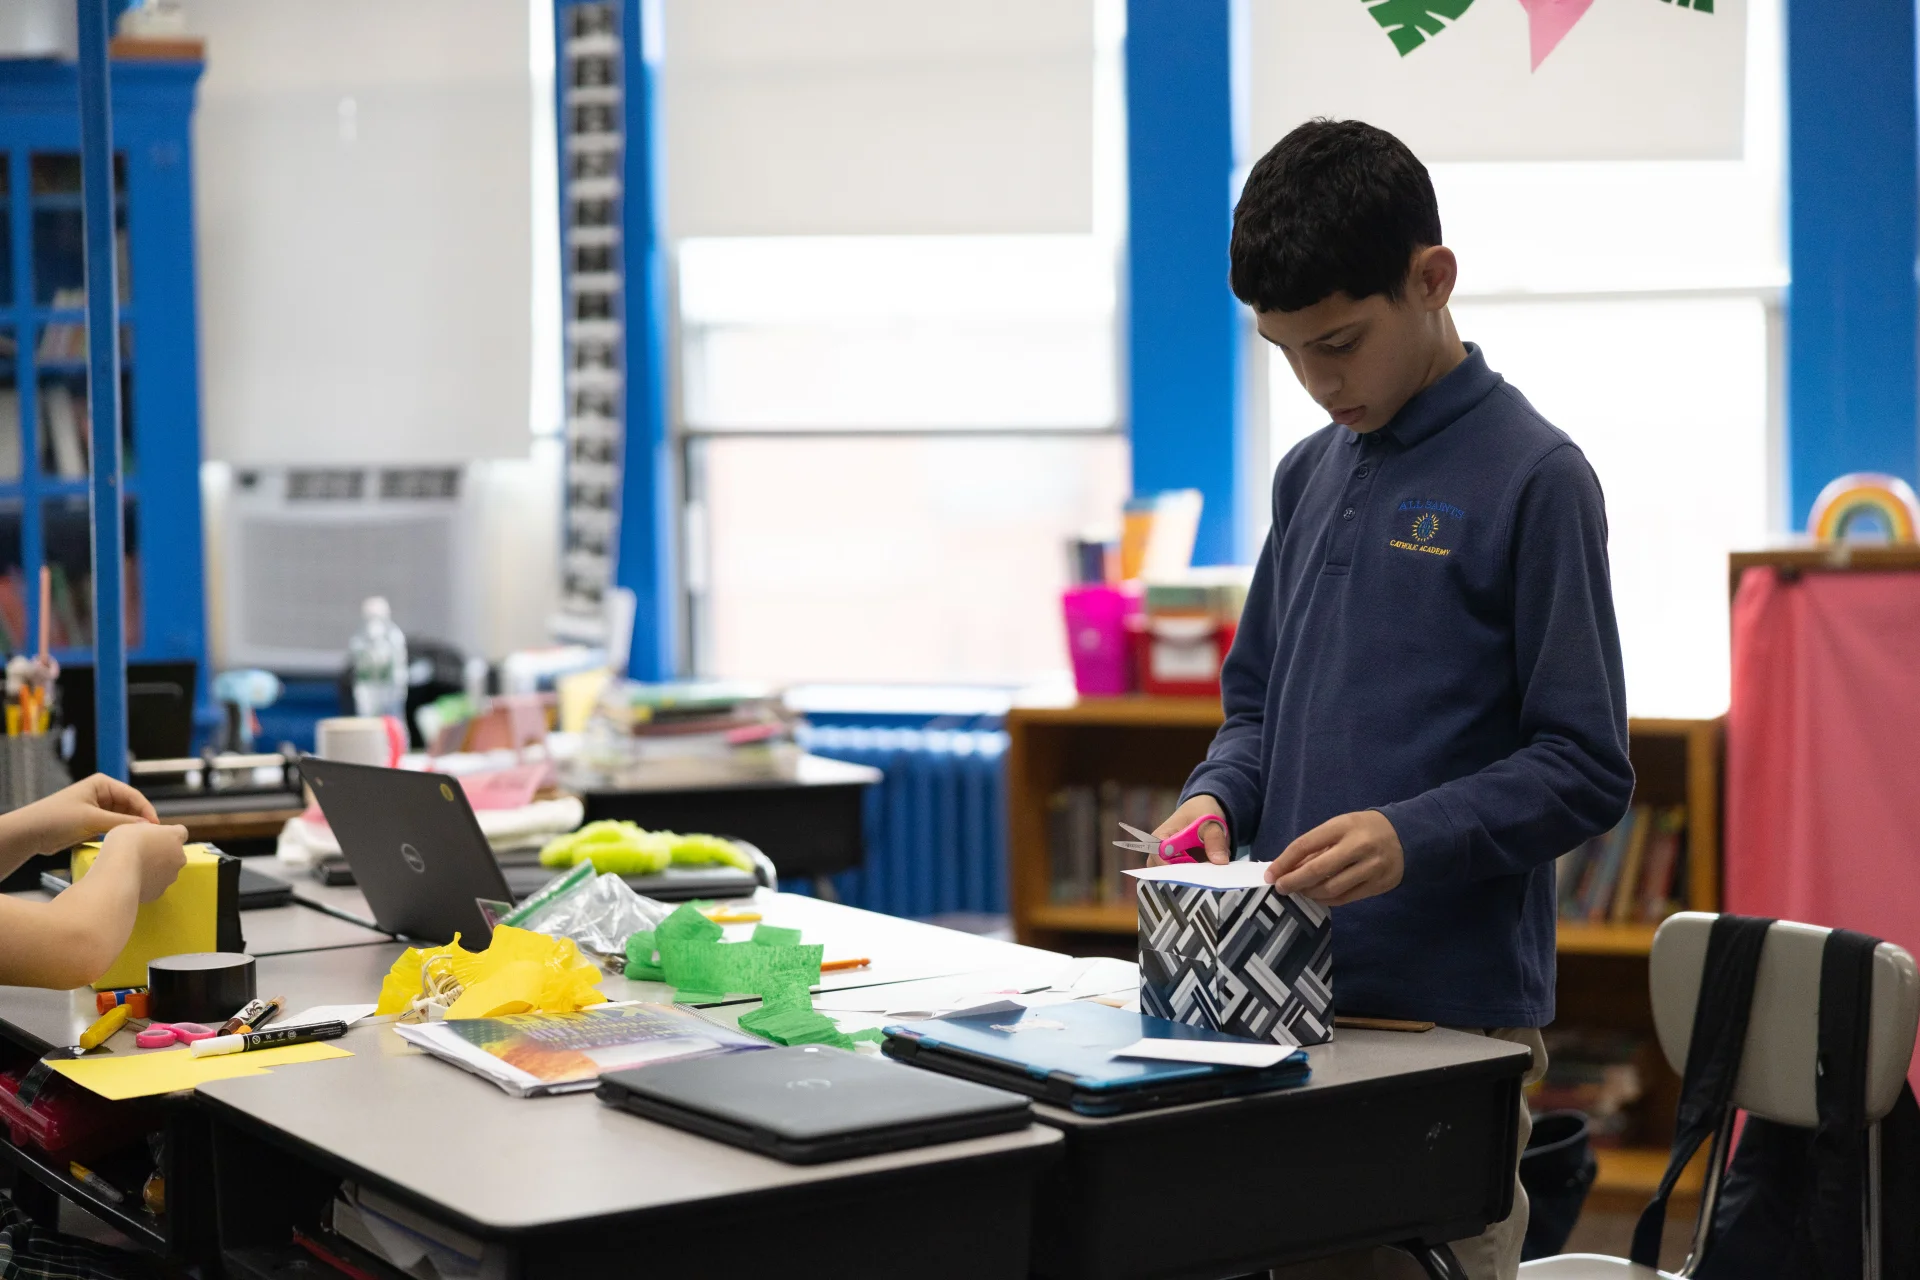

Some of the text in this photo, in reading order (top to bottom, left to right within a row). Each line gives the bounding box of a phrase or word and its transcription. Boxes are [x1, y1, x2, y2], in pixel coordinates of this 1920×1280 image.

[1398, 500, 1465, 519] ALL SAINTS
[1389, 539, 1451, 556] CATHOLIC ACADEMY
